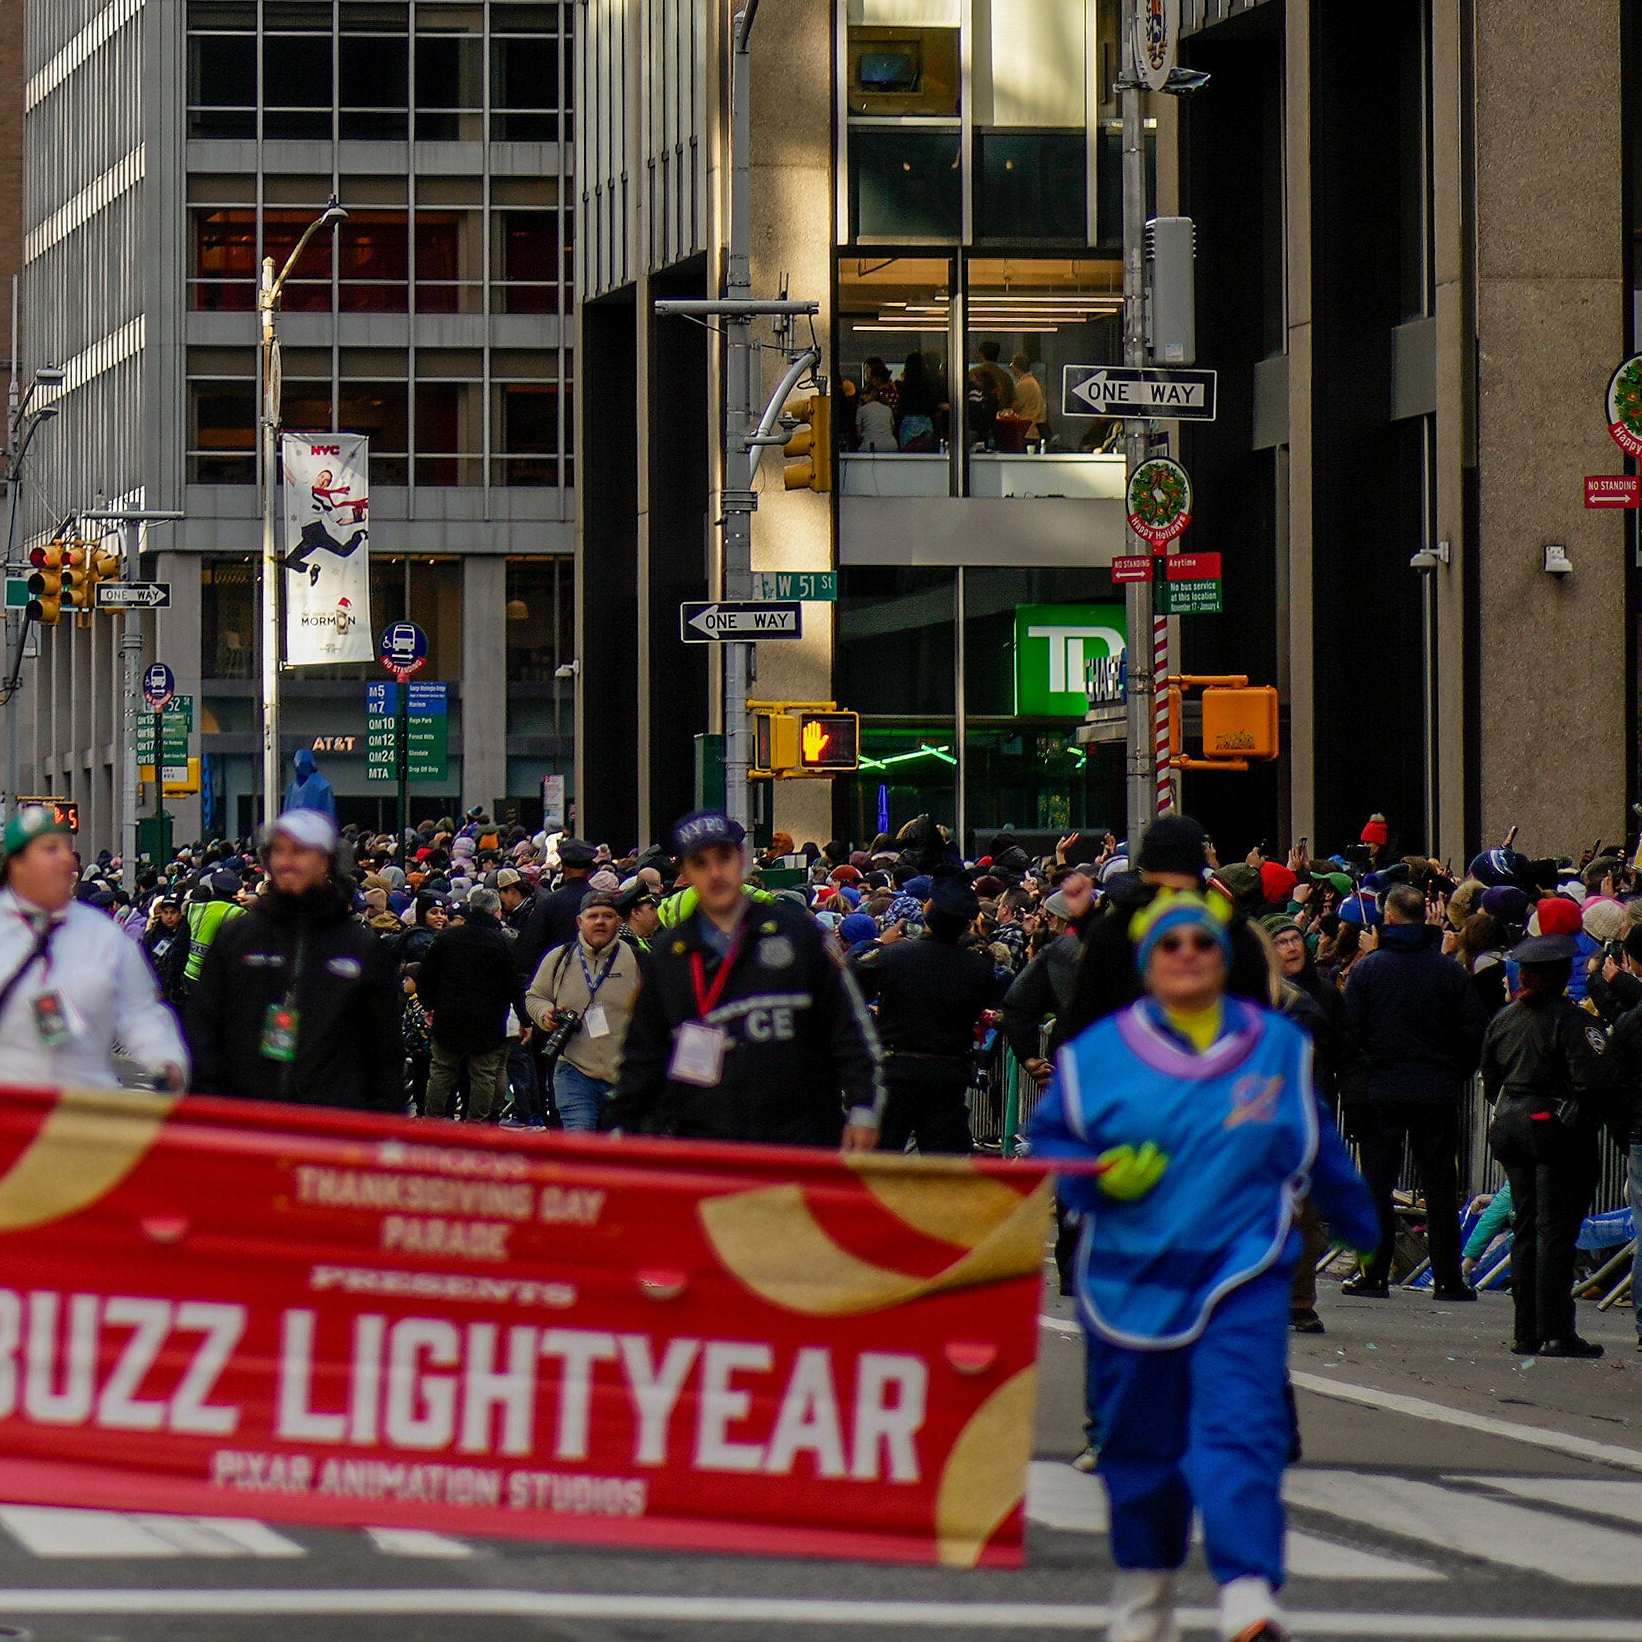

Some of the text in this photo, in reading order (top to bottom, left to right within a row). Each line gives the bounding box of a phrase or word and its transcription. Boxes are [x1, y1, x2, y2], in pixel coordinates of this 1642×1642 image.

[1088, 382, 1195, 403] ONE WAY
[1613, 426, 1642, 455] Happy
[311, 445, 340, 456] NYC
[1588, 481, 1637, 491] NO STANDING
[1131, 515, 1187, 540] Happy Holidays
[1123, 559, 1150, 568] STANDING
[1169, 559, 1197, 567] Anytime
[778, 575, 832, 598] W 51 St
[1170, 581, 1216, 591] No bus service
[106, 591, 159, 600] ONE WAY
[1170, 592, 1217, 602] at this location
[1170, 604, 1191, 612] November
[1191, 602, 1197, 611] 17
[1200, 602, 1216, 611] January
[706, 613, 789, 629] ONE WAY
[382, 658, 423, 675] NO STANDING
[1028, 626, 1126, 693] TD
[369, 684, 385, 697] M5
[168, 697, 180, 711] 52
[369, 700, 385, 713] M7
[368, 717, 395, 730] QM10
[312, 736, 356, 752] AT&T
[368, 733, 395, 746] QM12
[368, 749, 395, 762] QM24
[368, 768, 389, 779] MTA
[679, 816, 725, 844] NYPD
[296, 1164, 606, 1226] THANKSGIVING DAY
[381, 1214, 513, 1260] PARADE
[309, 1264, 578, 1308] PRESENTS
[276, 1308, 927, 1483] LIGHTYEAR
[213, 1449, 647, 1518] PIXAR ANIMATION STUDIOS
